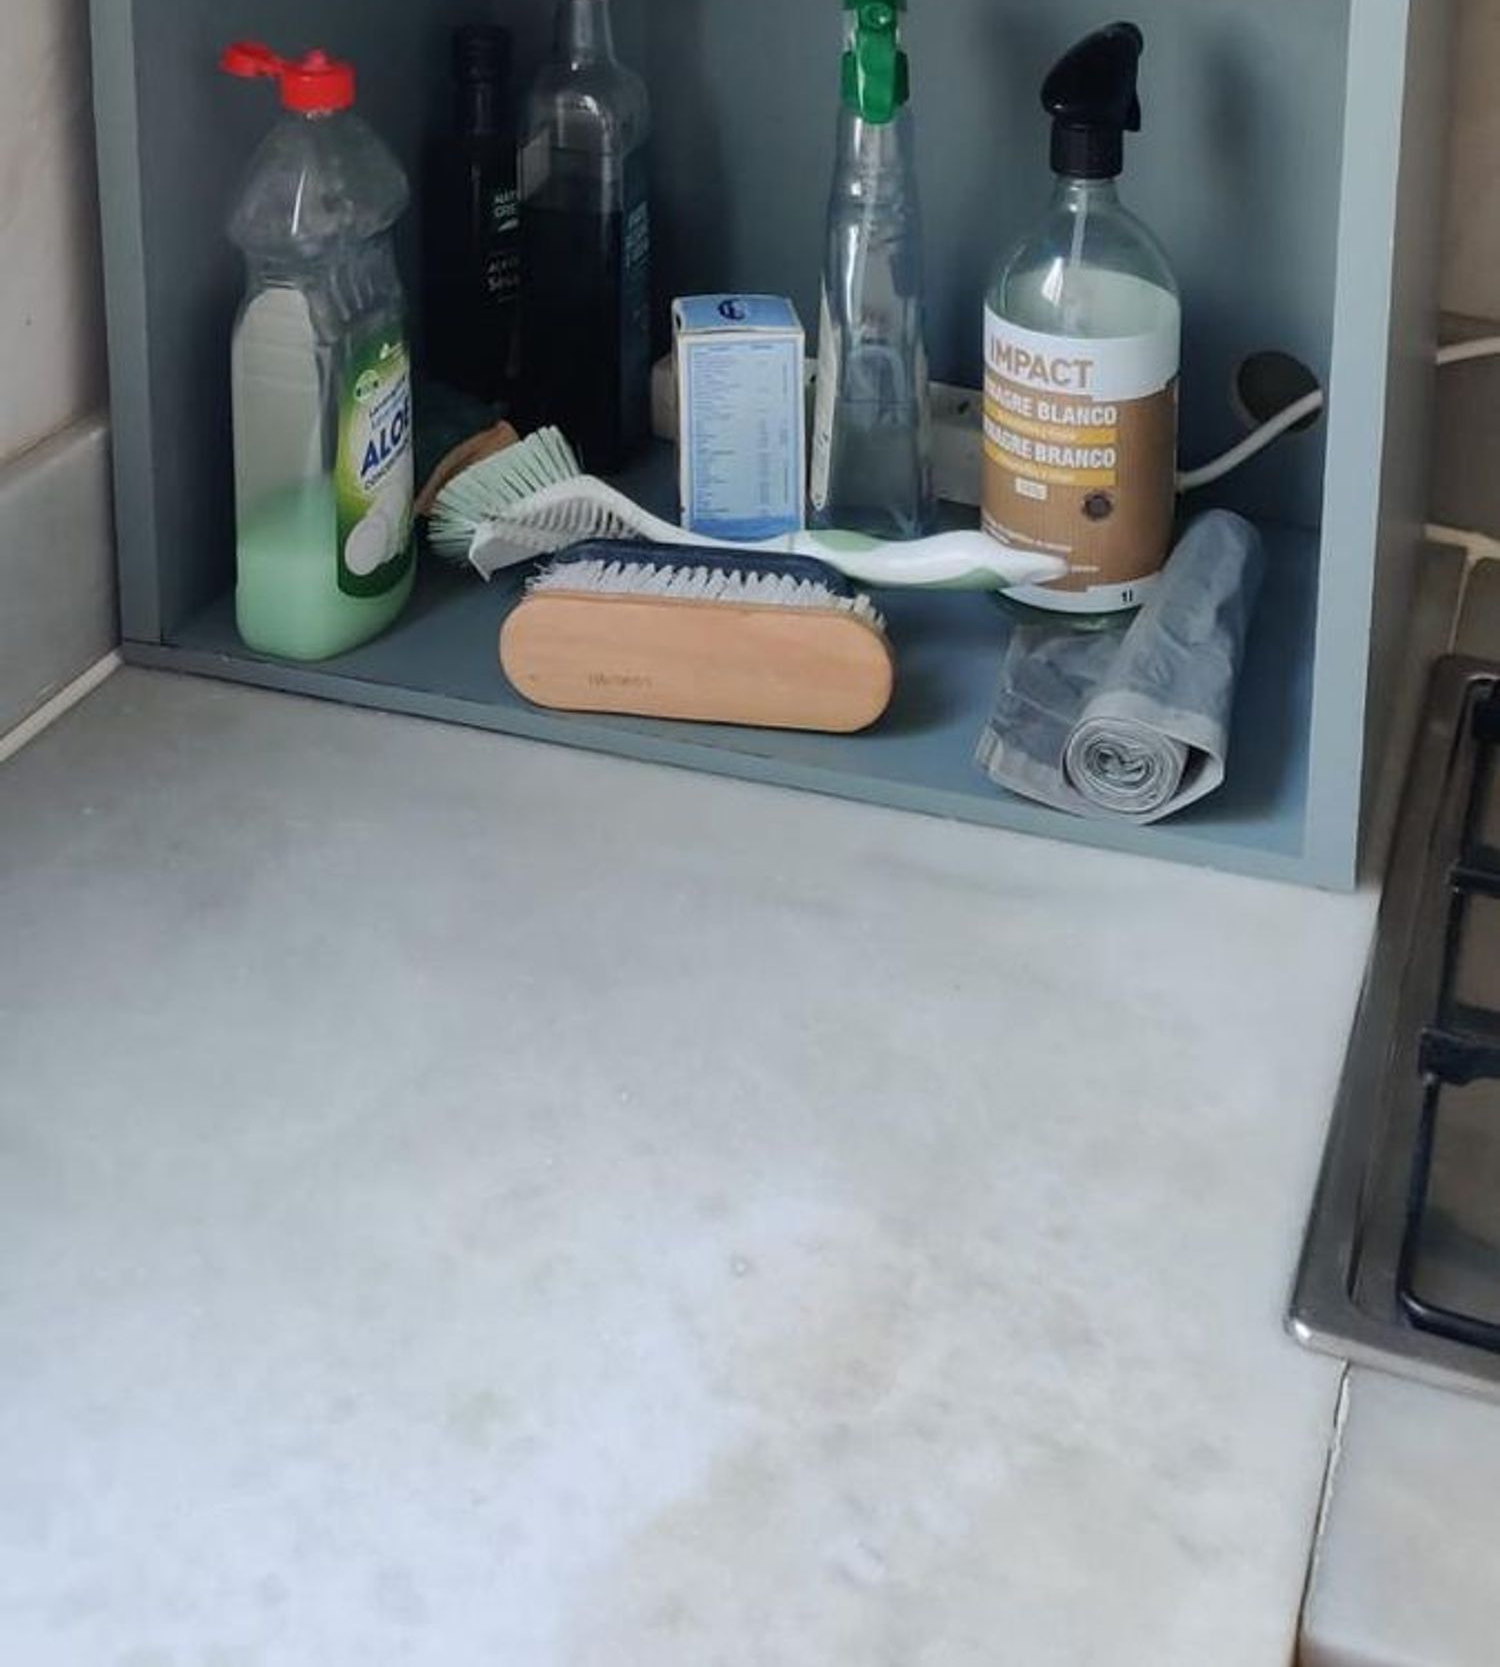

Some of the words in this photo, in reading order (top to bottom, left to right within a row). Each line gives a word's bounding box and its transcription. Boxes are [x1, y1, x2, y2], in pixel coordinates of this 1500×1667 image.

[990, 334, 1094, 388] IMPACT
[1037, 401, 1117, 426] BLANCO
[1034, 442, 1117, 469] BRANCO
